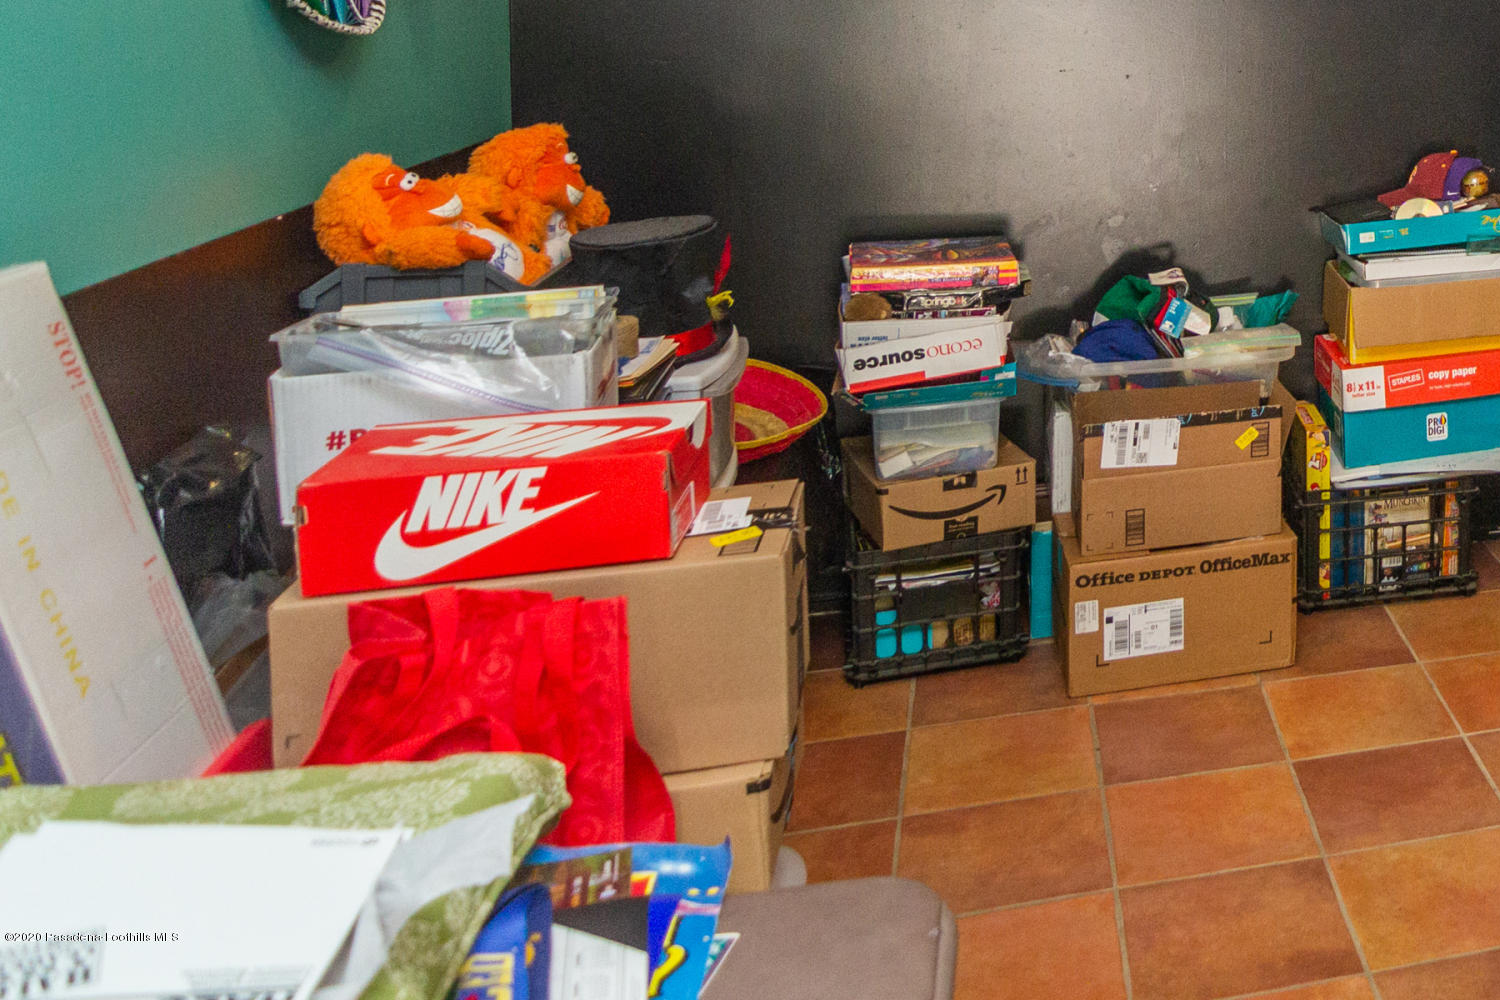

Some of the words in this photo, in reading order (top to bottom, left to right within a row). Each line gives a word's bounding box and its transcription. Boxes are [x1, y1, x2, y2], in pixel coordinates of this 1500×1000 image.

[48, 320, 87, 390] STOP!
[447, 324, 513, 356] Ziploc
[926, 337, 983, 358] econo
[853, 348, 925, 371] source
[1391, 373, 1421, 387] STAPLES
[1428, 369, 1450, 381] copy
[1452, 366, 1478, 379] paper
[404, 466, 548, 534] NIKE
[1075, 572, 1135, 589] Office
[1139, 566, 1195, 581] DEPOT
[1200, 552, 1290, 575] OfficeMax
[18, 535, 41, 572] IN
[40, 588, 90, 699] CHINA
